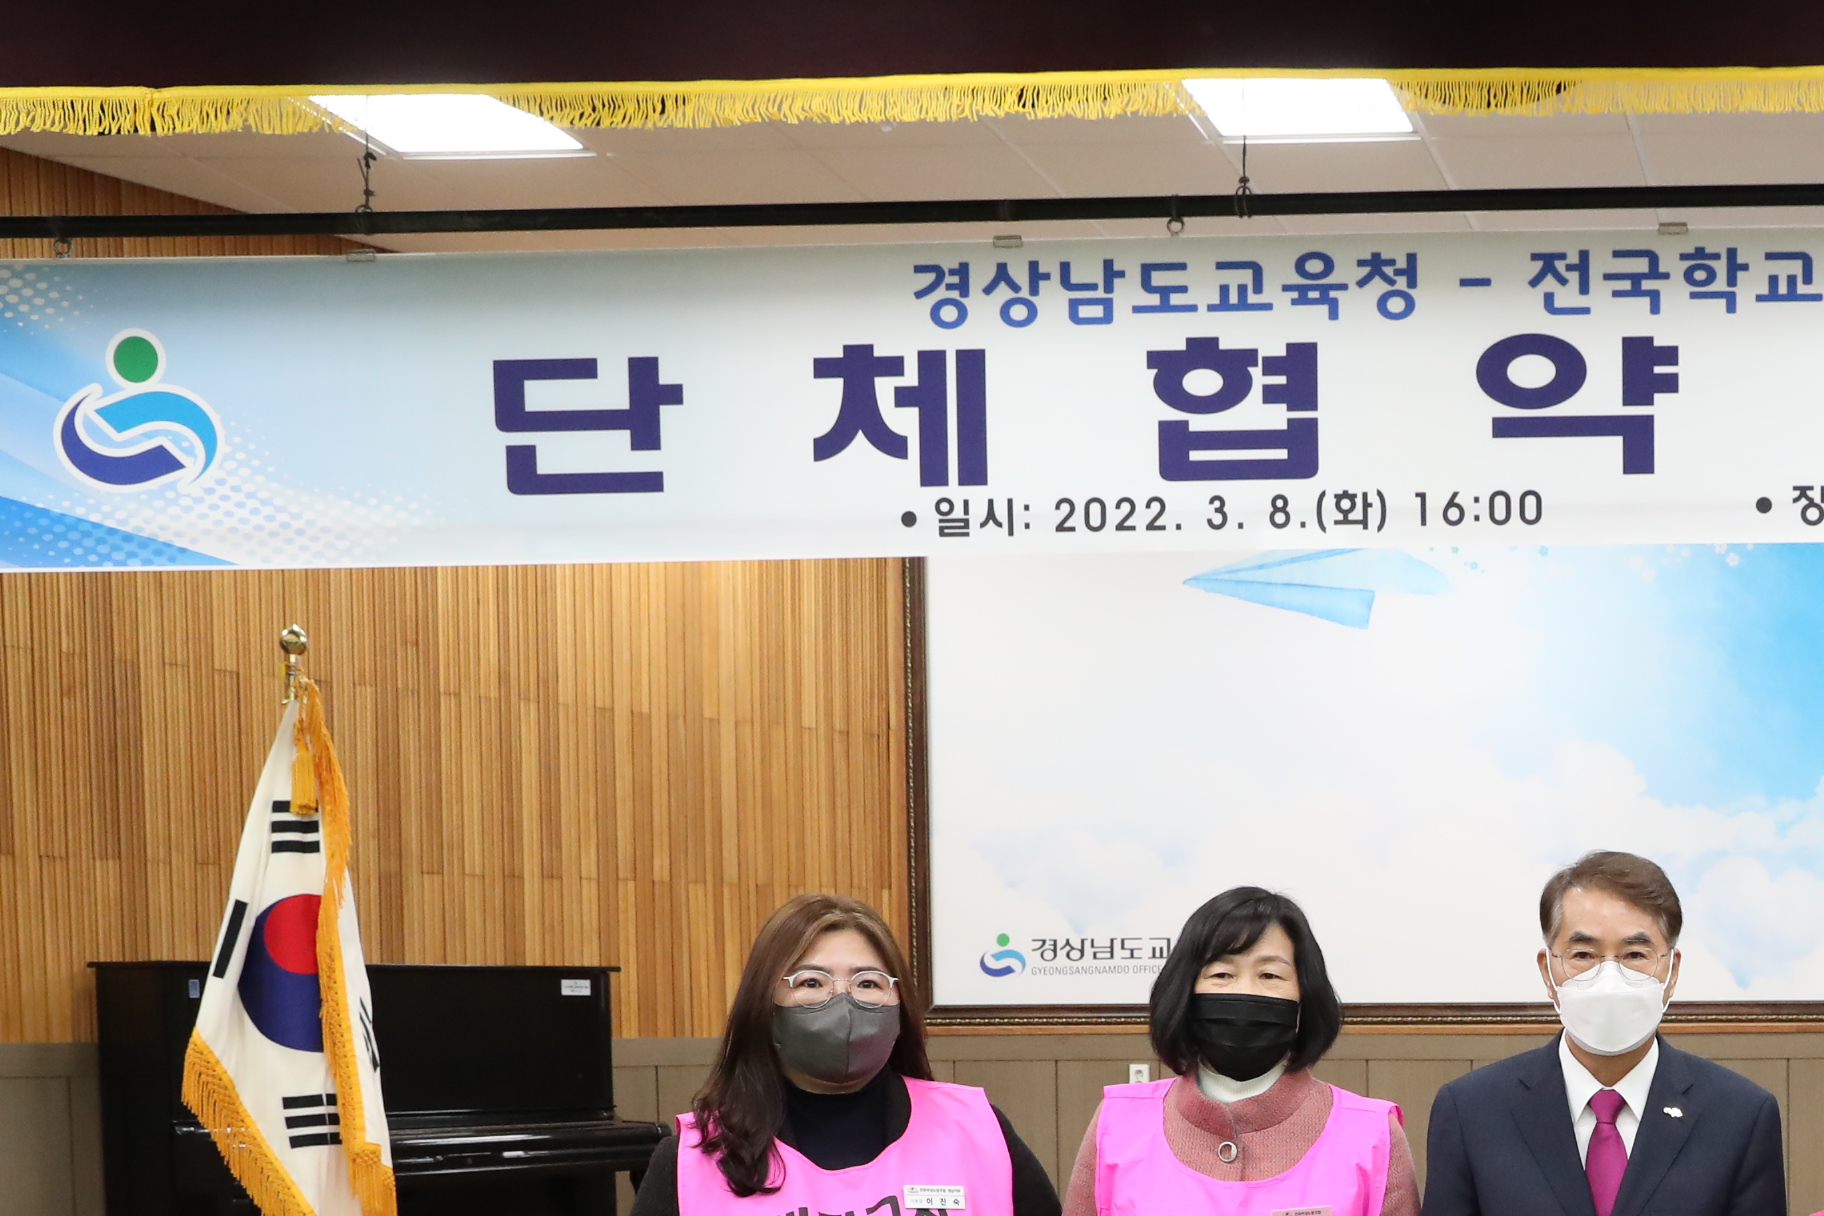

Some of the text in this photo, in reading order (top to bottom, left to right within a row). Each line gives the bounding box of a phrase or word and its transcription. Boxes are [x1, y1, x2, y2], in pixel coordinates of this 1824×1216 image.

[913, 252, 1418, 330] 경상남도교육청
[935, 497, 1031, 537] 일시:
[1055, 497, 1182, 533] 2022.
[1207, 496, 1244, 530] 3.
[1415, 490, 1542, 527] 16:00
[1031, 964, 1162, 976] GYEONGSANGNAMDO OFFICE
